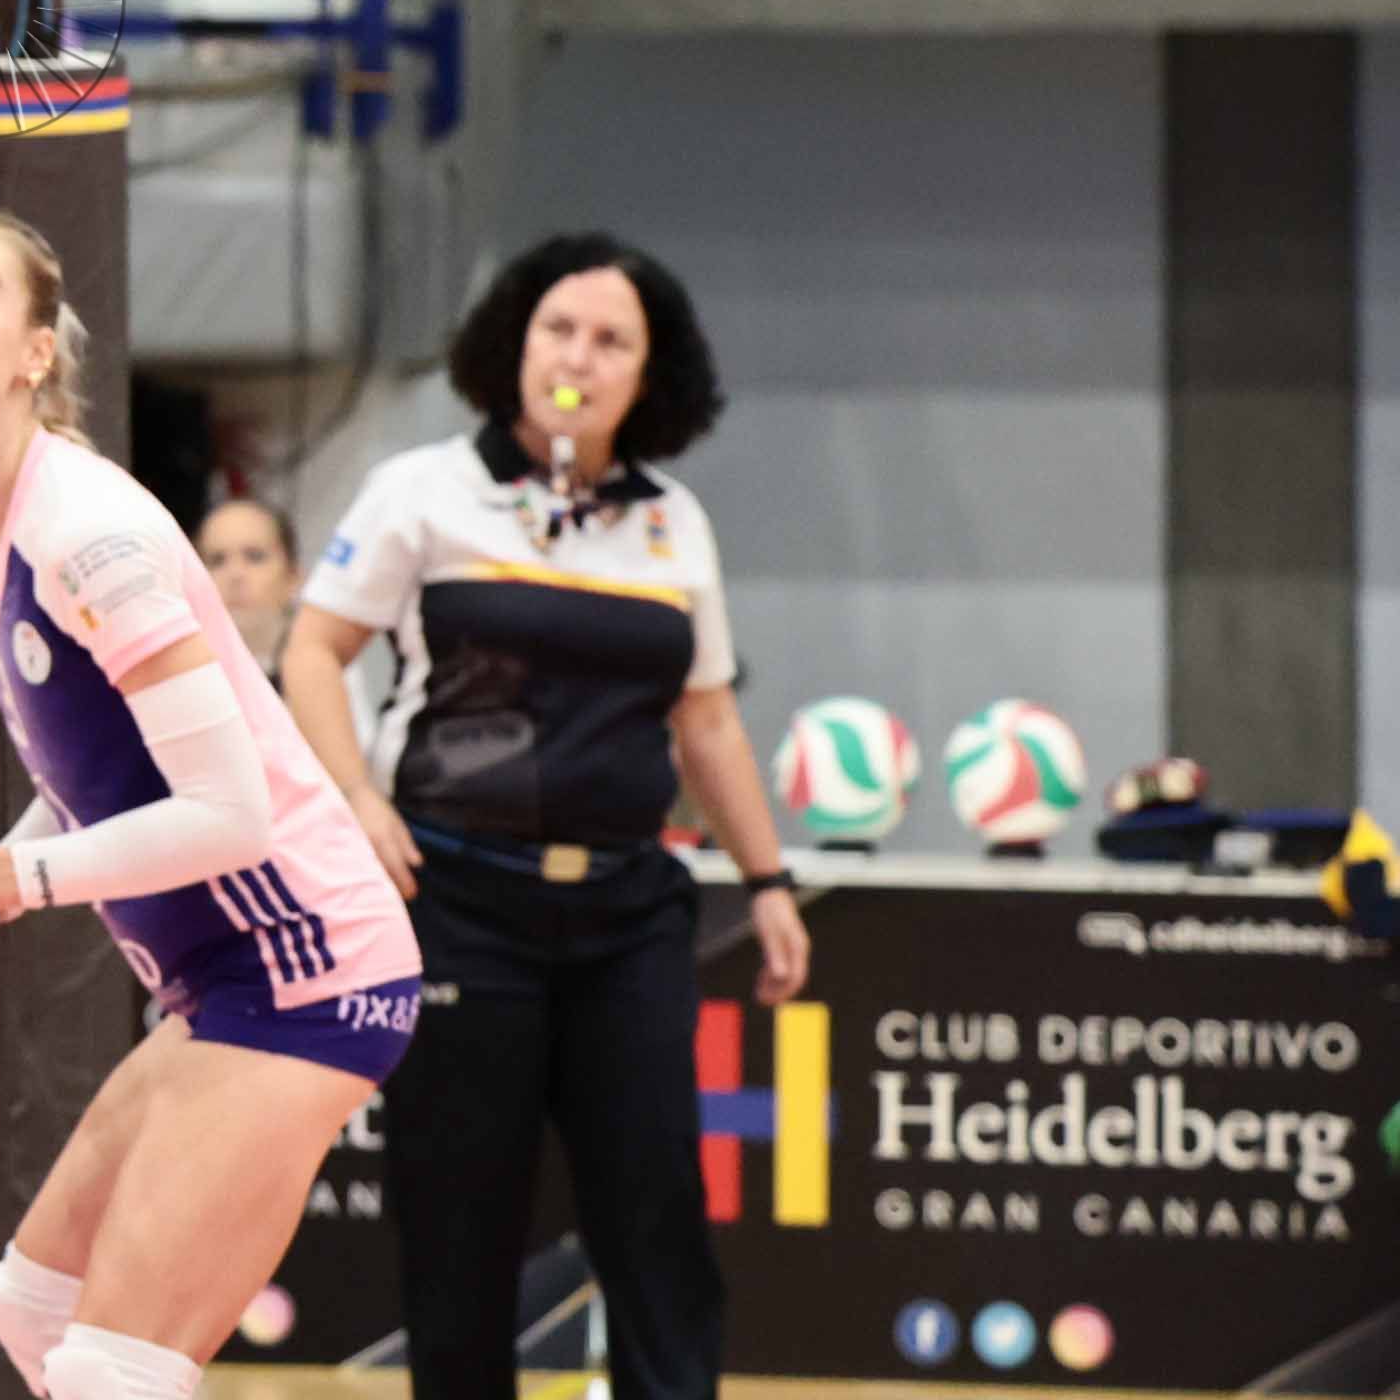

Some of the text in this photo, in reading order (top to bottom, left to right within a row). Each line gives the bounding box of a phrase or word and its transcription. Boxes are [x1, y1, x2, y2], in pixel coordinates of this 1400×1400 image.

[875, 1010, 1359, 1073] CLUB DEPORTIVO
[873, 1071, 1355, 1201] Heidelberg
[874, 1188, 1350, 1242] GRAN CANARIA
